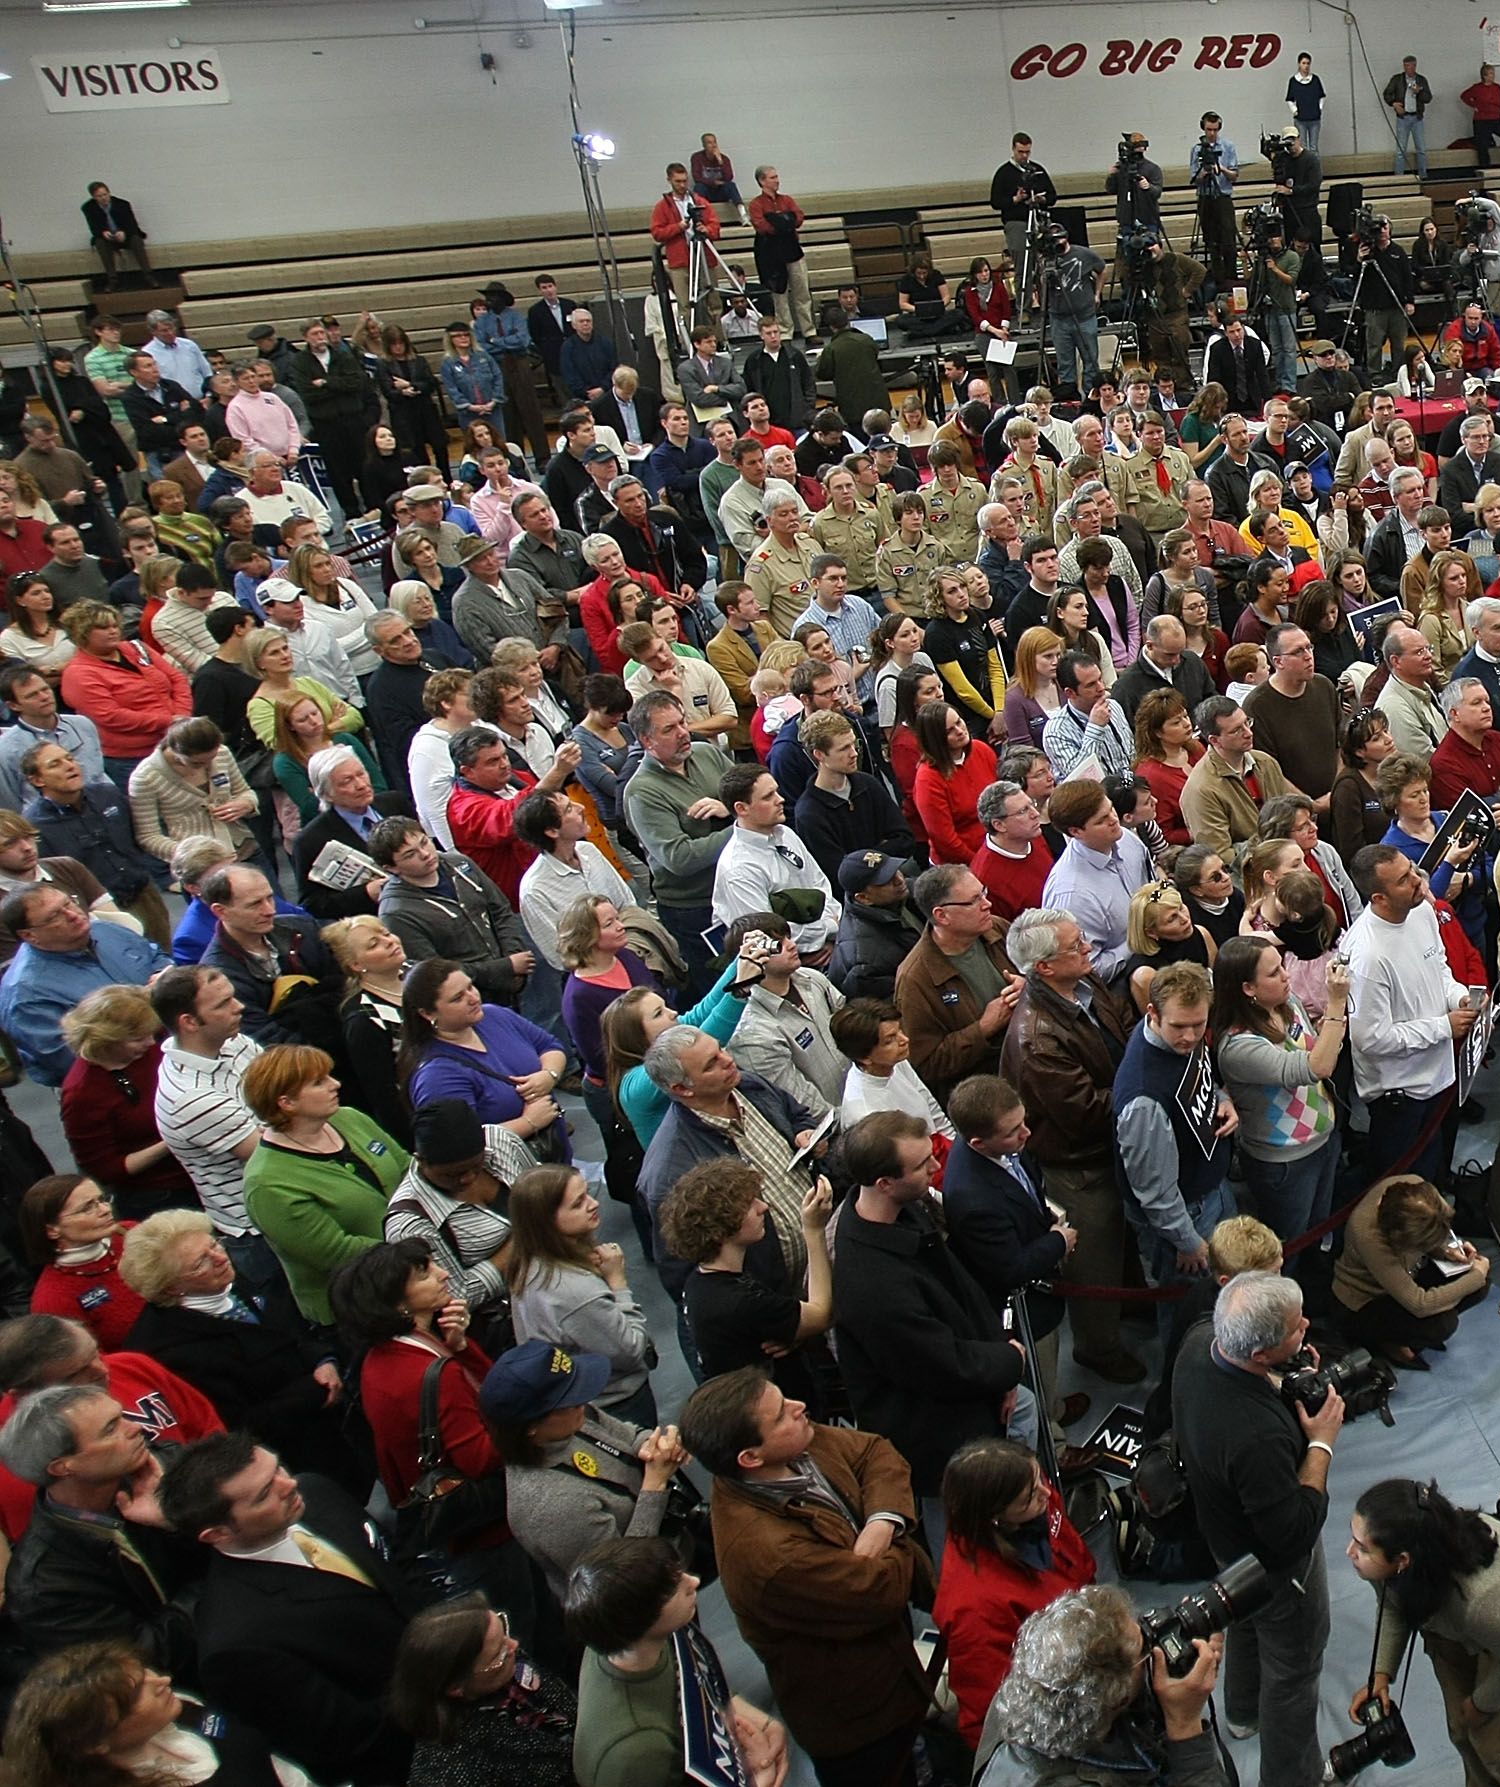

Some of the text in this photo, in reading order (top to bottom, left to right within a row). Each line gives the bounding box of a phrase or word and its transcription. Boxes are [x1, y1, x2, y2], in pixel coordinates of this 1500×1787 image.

[1010, 33, 1282, 80] GO BIG RED
[41, 59, 219, 97] VISITORS
